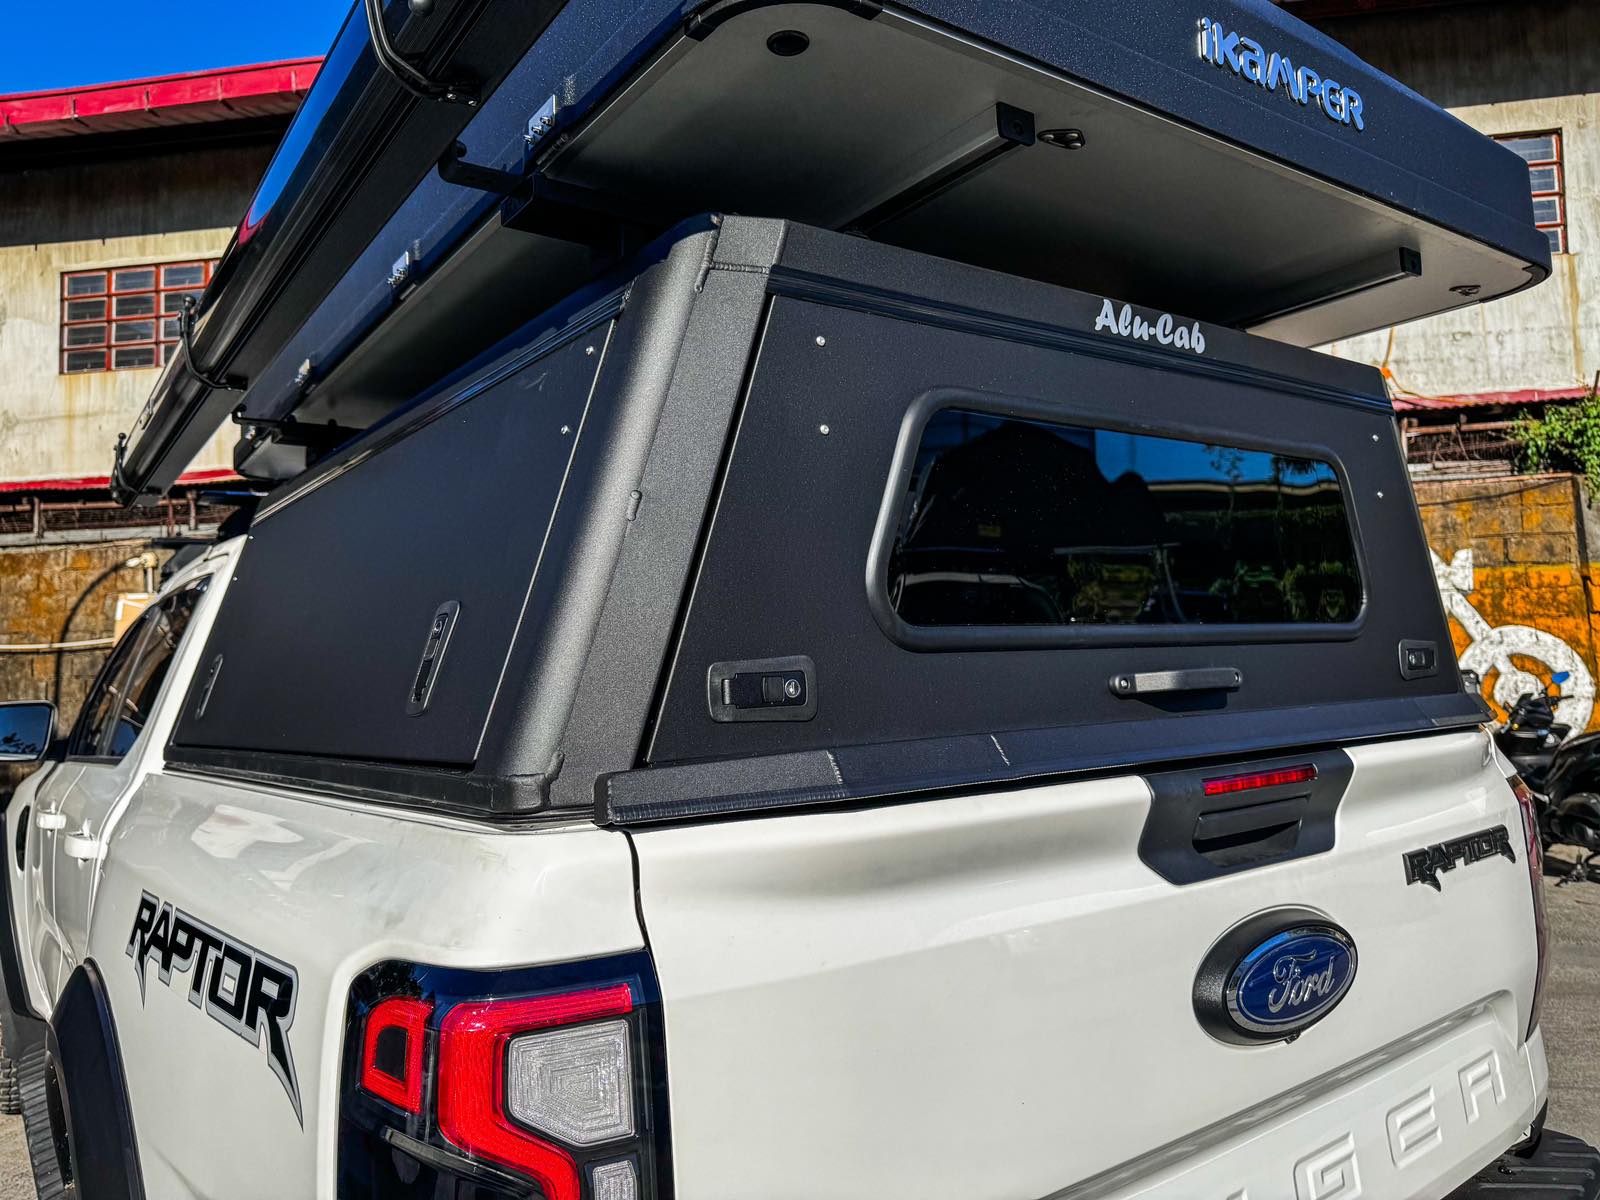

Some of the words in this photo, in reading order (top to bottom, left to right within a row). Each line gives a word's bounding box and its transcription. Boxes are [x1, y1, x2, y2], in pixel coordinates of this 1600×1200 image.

[1402, 824, 1516, 893] RAPTOR
[125, 888, 304, 1134] RAPTOR
[1268, 949, 1335, 1014] Ford
[1226, 1050, 1506, 1200] GER
